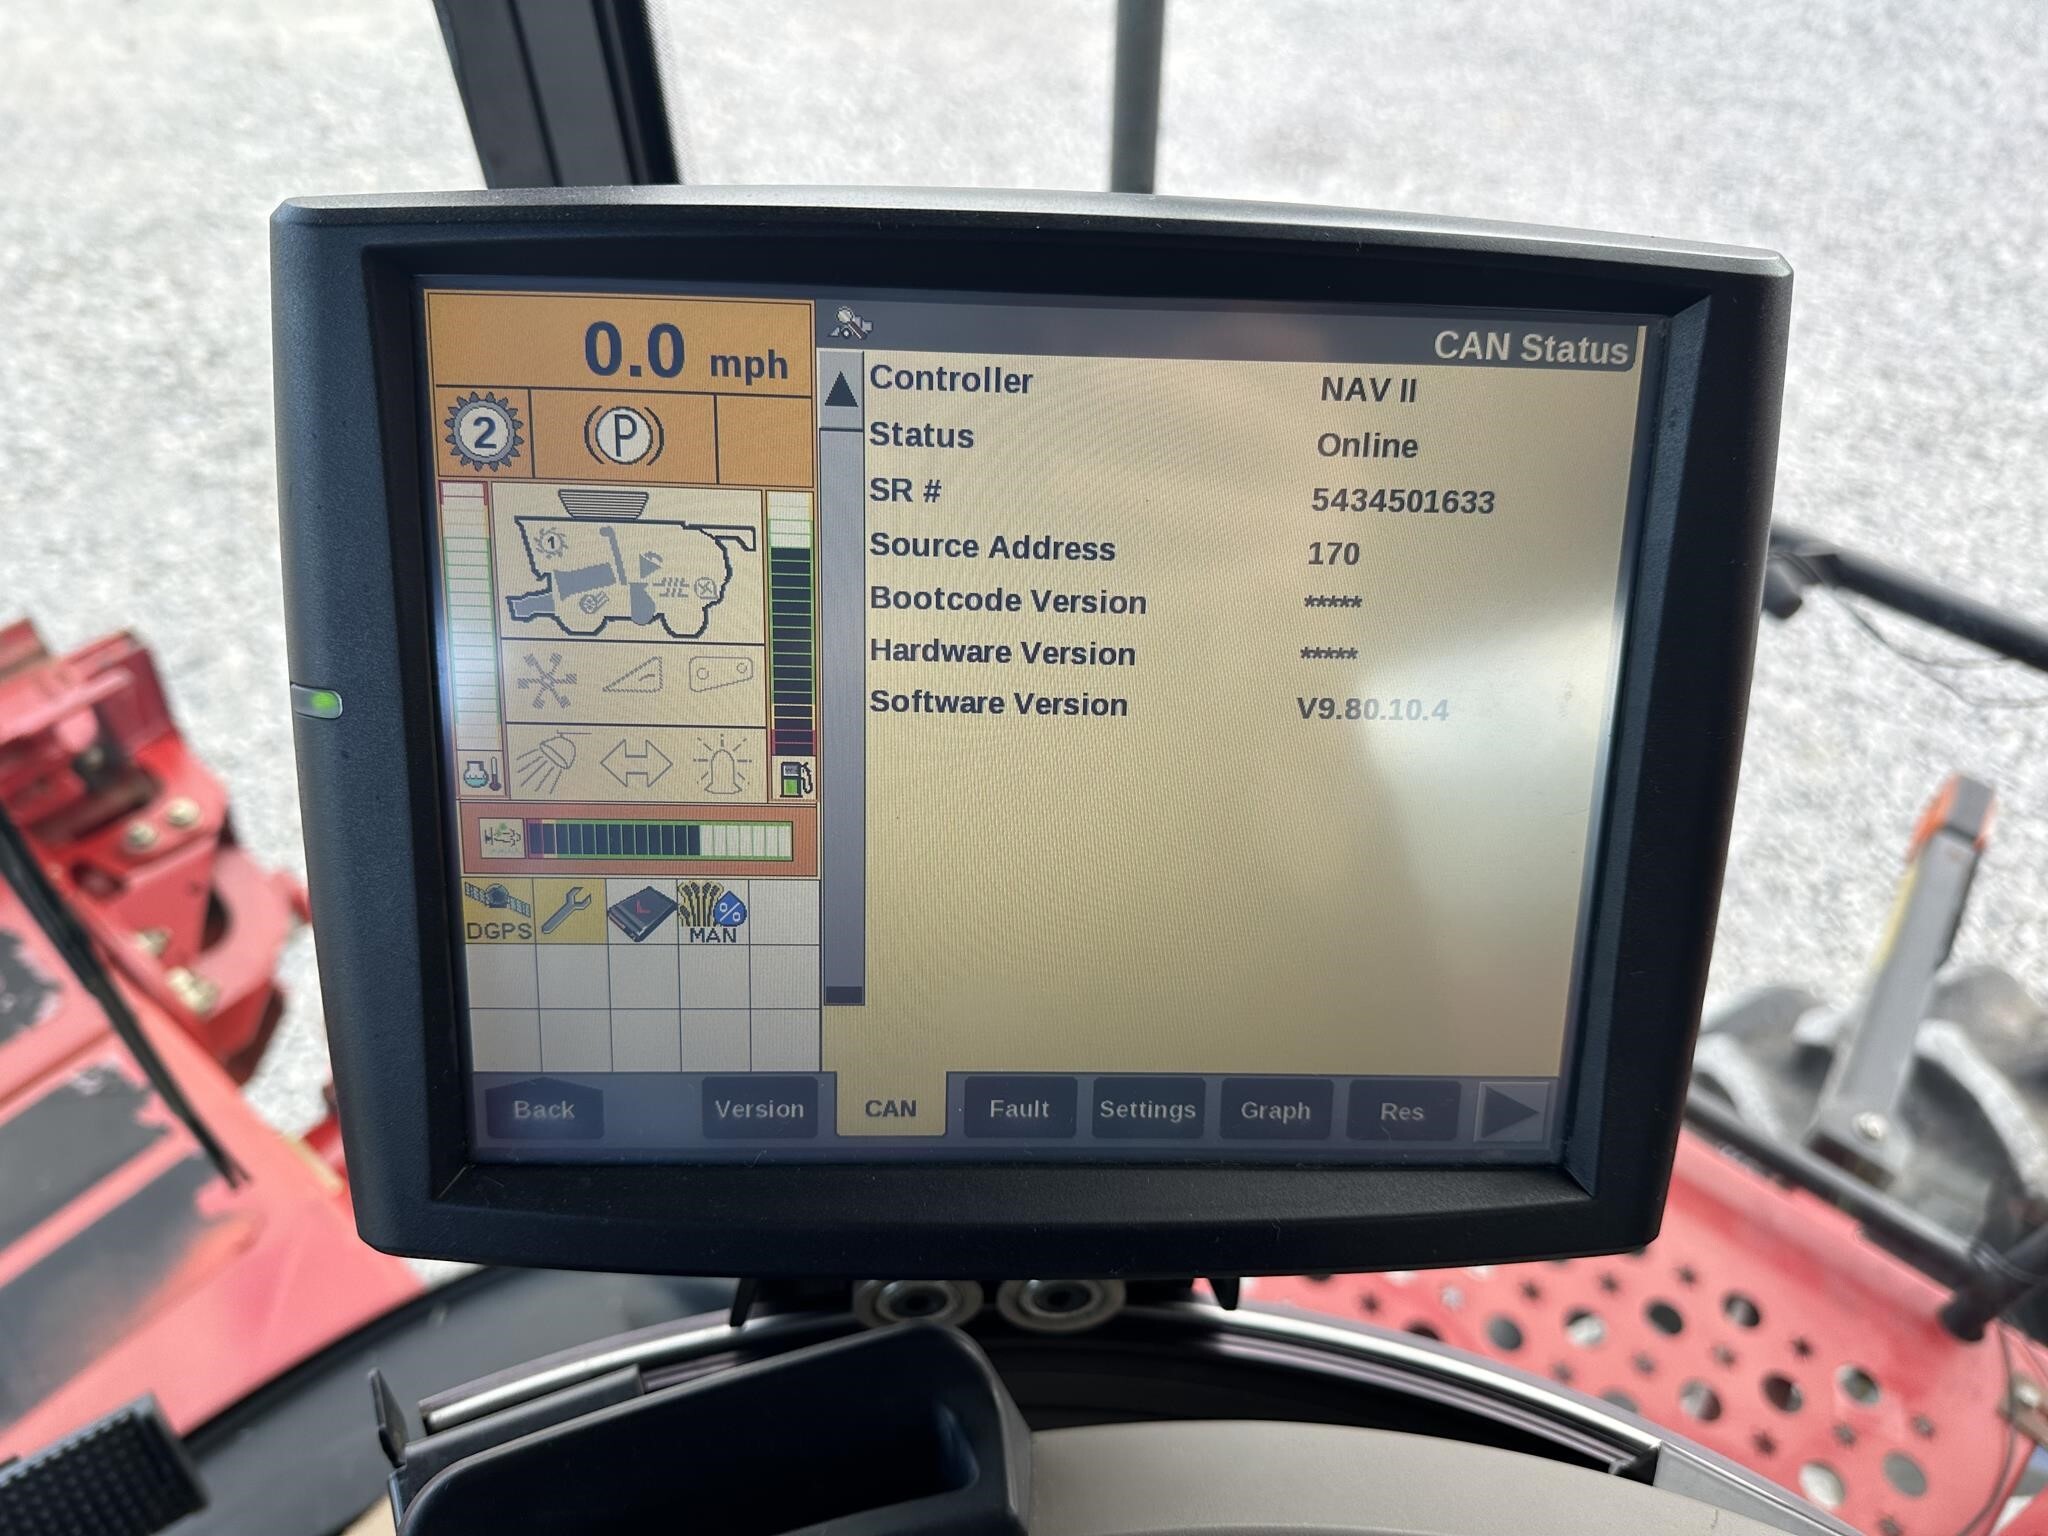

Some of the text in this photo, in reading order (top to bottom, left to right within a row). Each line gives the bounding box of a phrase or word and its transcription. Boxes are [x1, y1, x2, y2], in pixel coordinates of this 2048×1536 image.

[584, 320, 788, 386] 0.0 mph
[1434, 330, 1629, 365] CAN Status
[869, 364, 1034, 394] Controller
[1320, 377, 1417, 403] NAV II
[472, 415, 497, 449] 2
[614, 414, 638, 458] P
[869, 421, 975, 449] Status
[1316, 432, 1419, 458] Online
[869, 478, 942, 503] SR #
[1311, 488, 1495, 514] 5434501633
[869, 532, 1116, 561] Source Address
[1307, 542, 1360, 565] 170
[870, 586, 1148, 614] Bootcode Version
[870, 639, 1136, 666] Hardware Version
[869, 689, 1128, 716] Software Version
[1296, 697, 1449, 721] V9.80.10.4
[467, 922, 532, 941] DGPS
[690, 927, 737, 944] MAN
[513, 1100, 576, 1120] Back
[715, 1100, 804, 1119] Version
[865, 1100, 917, 1118] CAN
[989, 1099, 1050, 1120] Fault
[1099, 1099, 1197, 1123] Settings
[1240, 1101, 1311, 1124] Graph
[1381, 1102, 1424, 1122] Res
